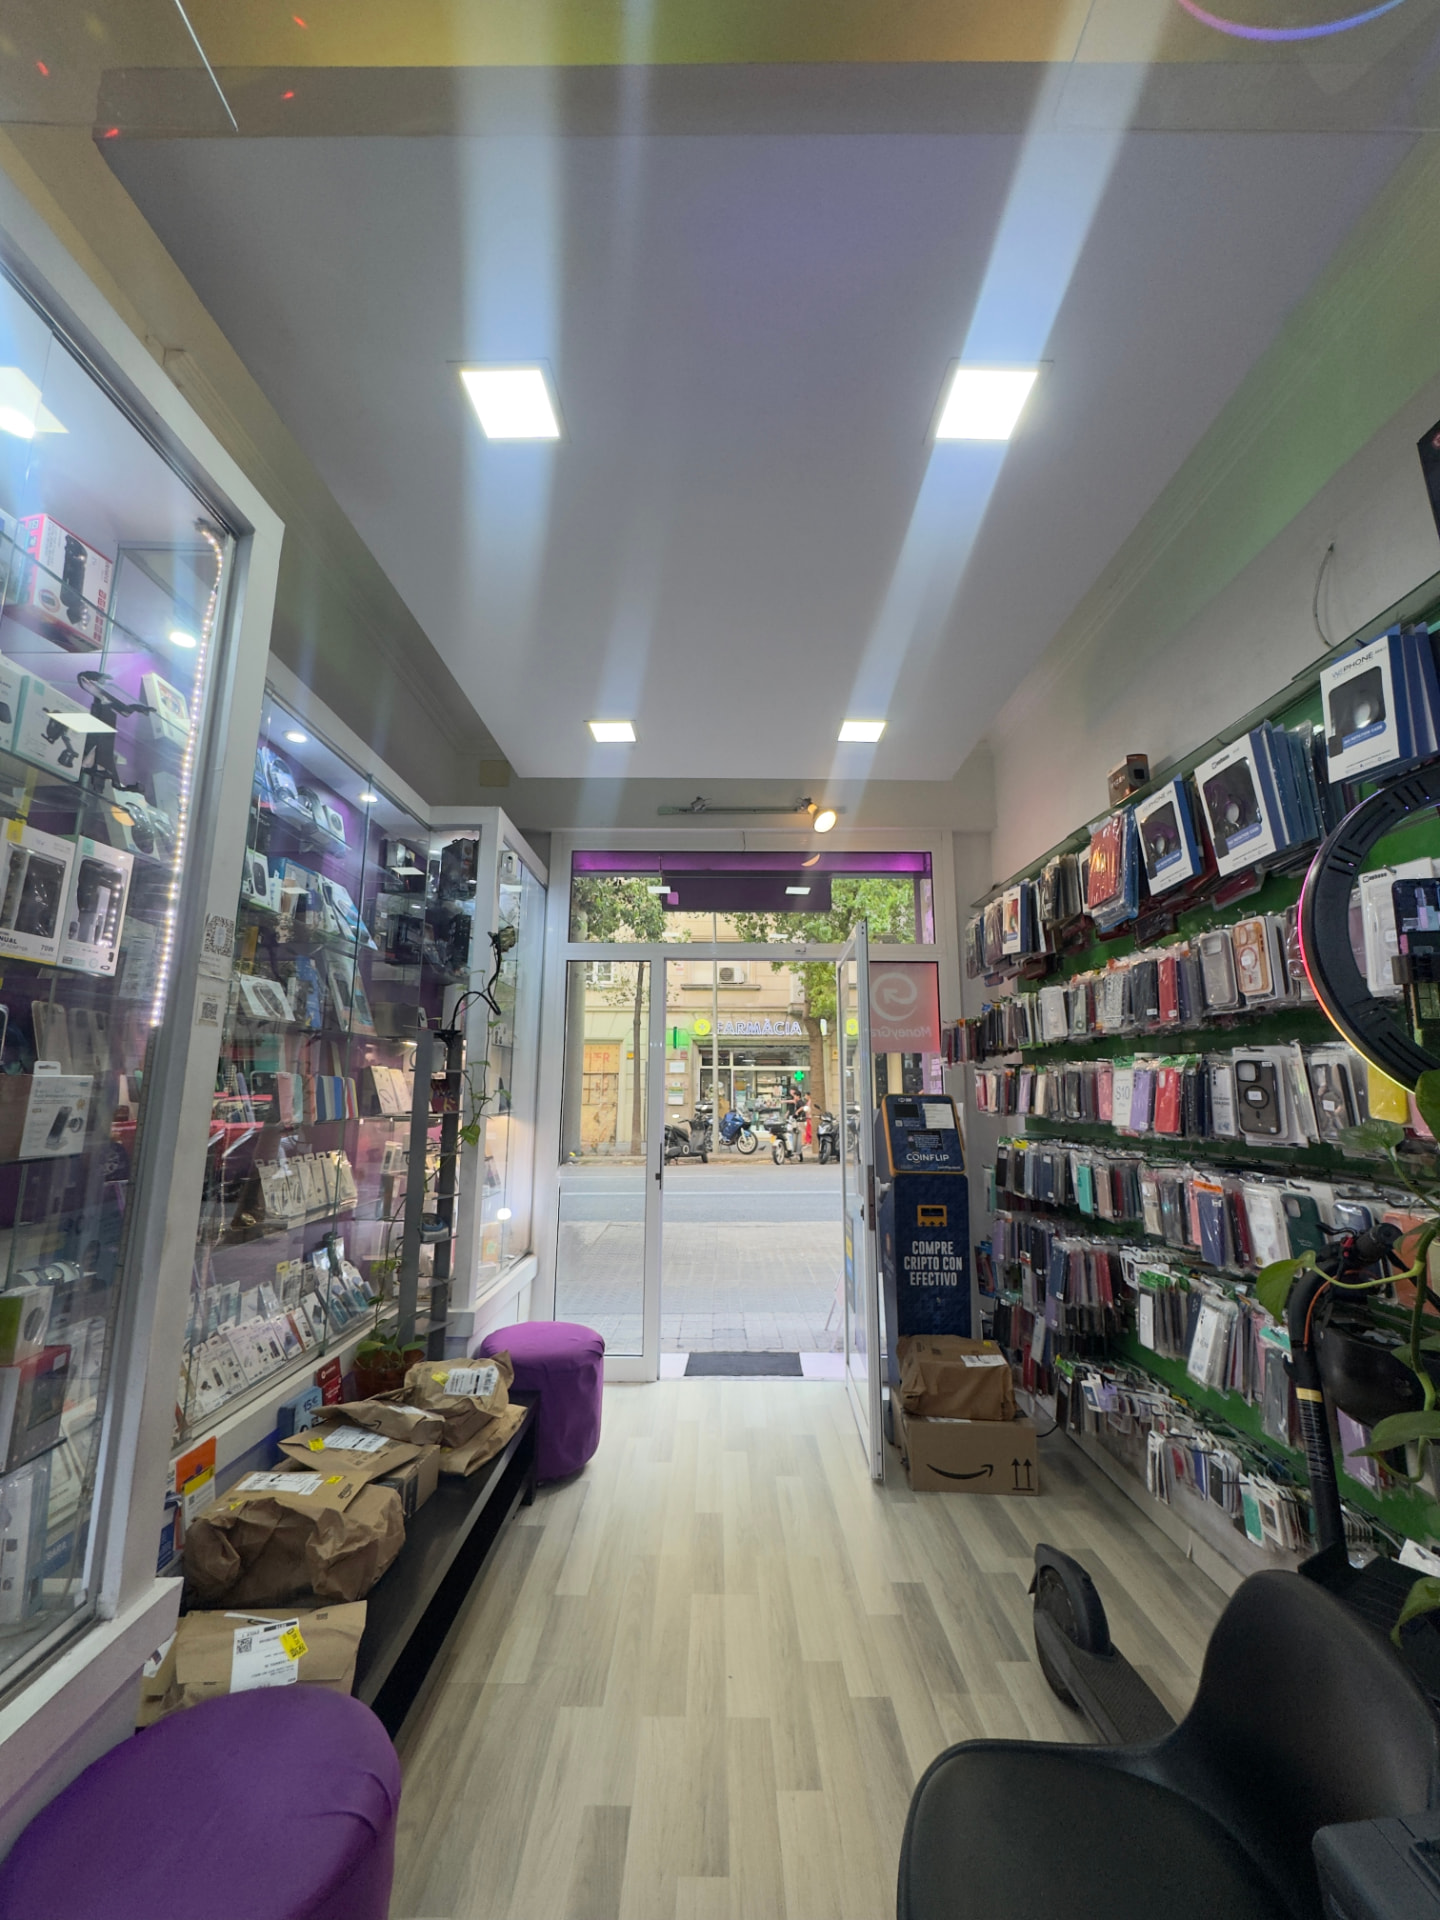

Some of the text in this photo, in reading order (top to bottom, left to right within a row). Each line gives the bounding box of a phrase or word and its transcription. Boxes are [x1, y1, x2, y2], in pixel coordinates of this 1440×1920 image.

[1115, 1086, 1130, 1100] S10
[906, 1152, 950, 1162] COINFLIP
[912, 1241, 954, 1255] COMPRE
[904, 1256, 963, 1270] CRIPTO CON
[910, 1271, 957, 1286] EFECTIVO
